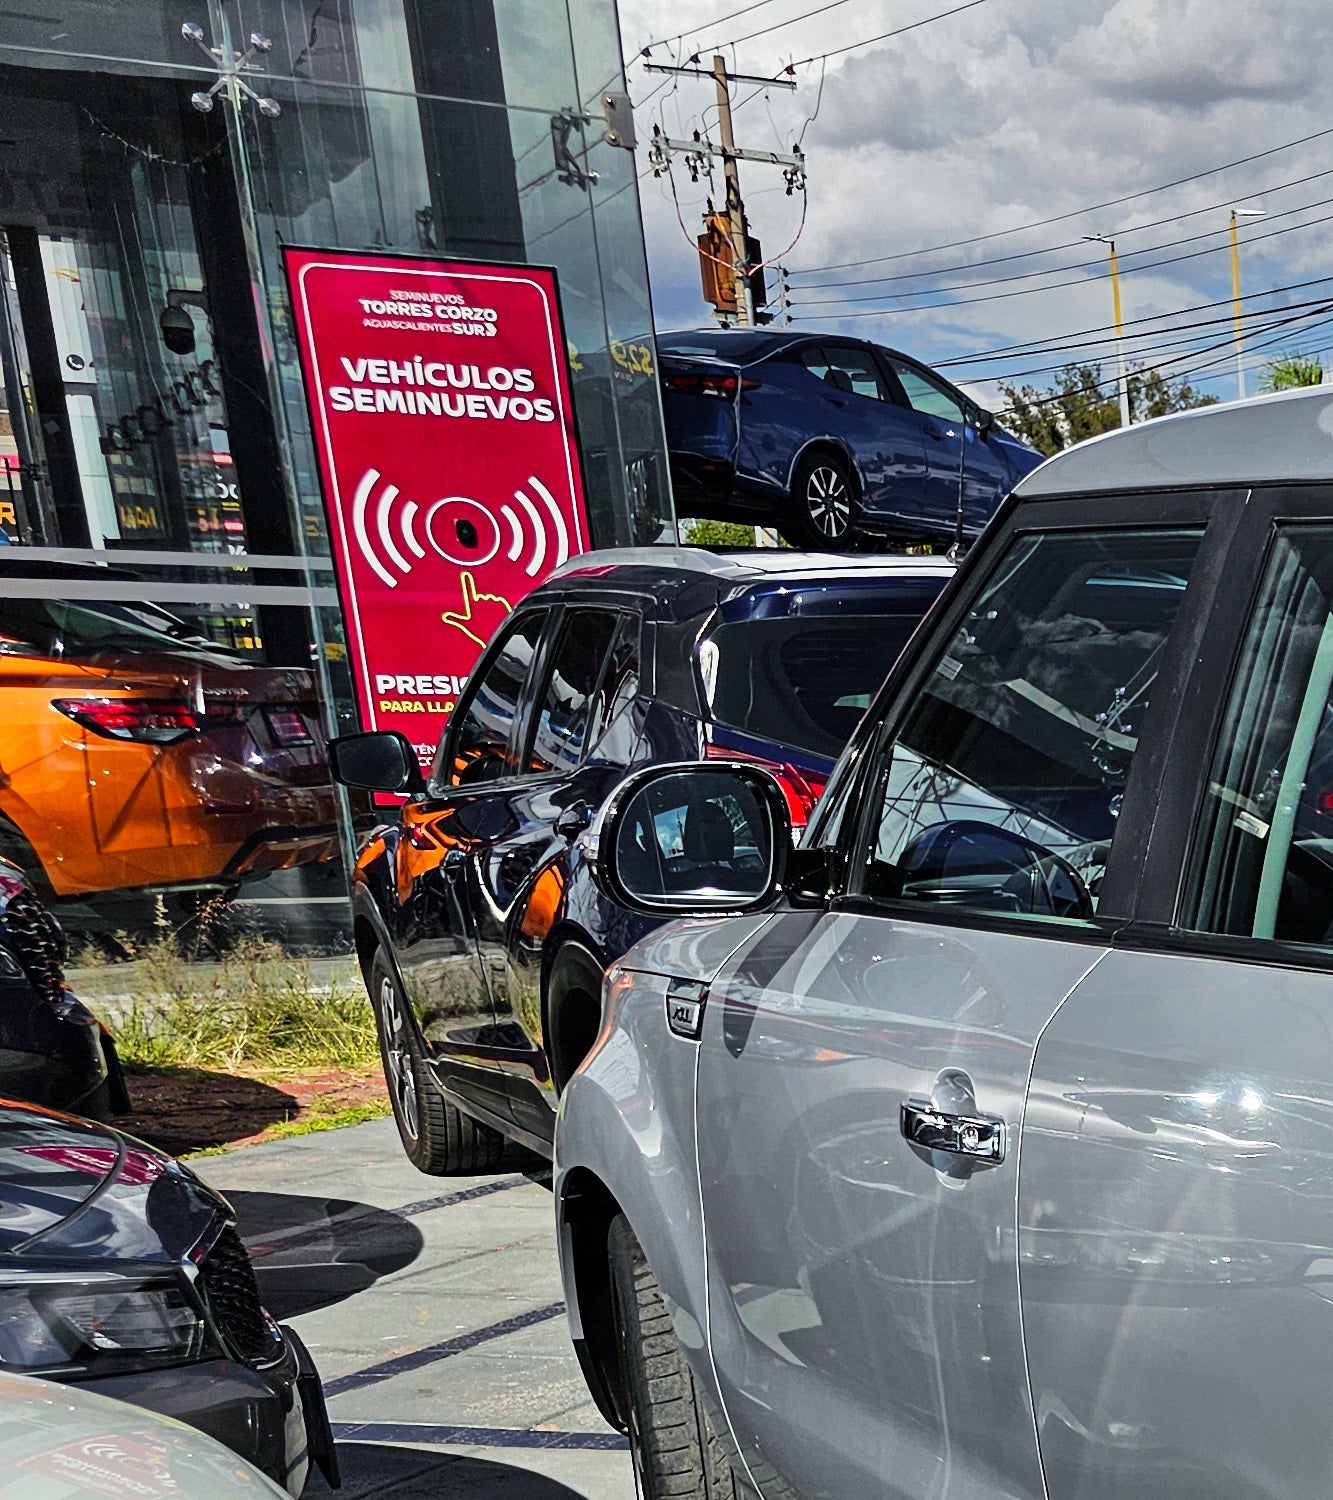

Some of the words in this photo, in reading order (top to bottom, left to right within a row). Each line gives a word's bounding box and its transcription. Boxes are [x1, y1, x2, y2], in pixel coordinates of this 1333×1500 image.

[389, 289, 465, 305] SEMINUEVOS
[358, 299, 433, 318] TORRES
[436, 304, 498, 322] CORZO
[340, 355, 535, 392] VEHÍCULOS
[329, 386, 555, 422] SEMINUEVOS
[380, 701, 425, 713] PARA
